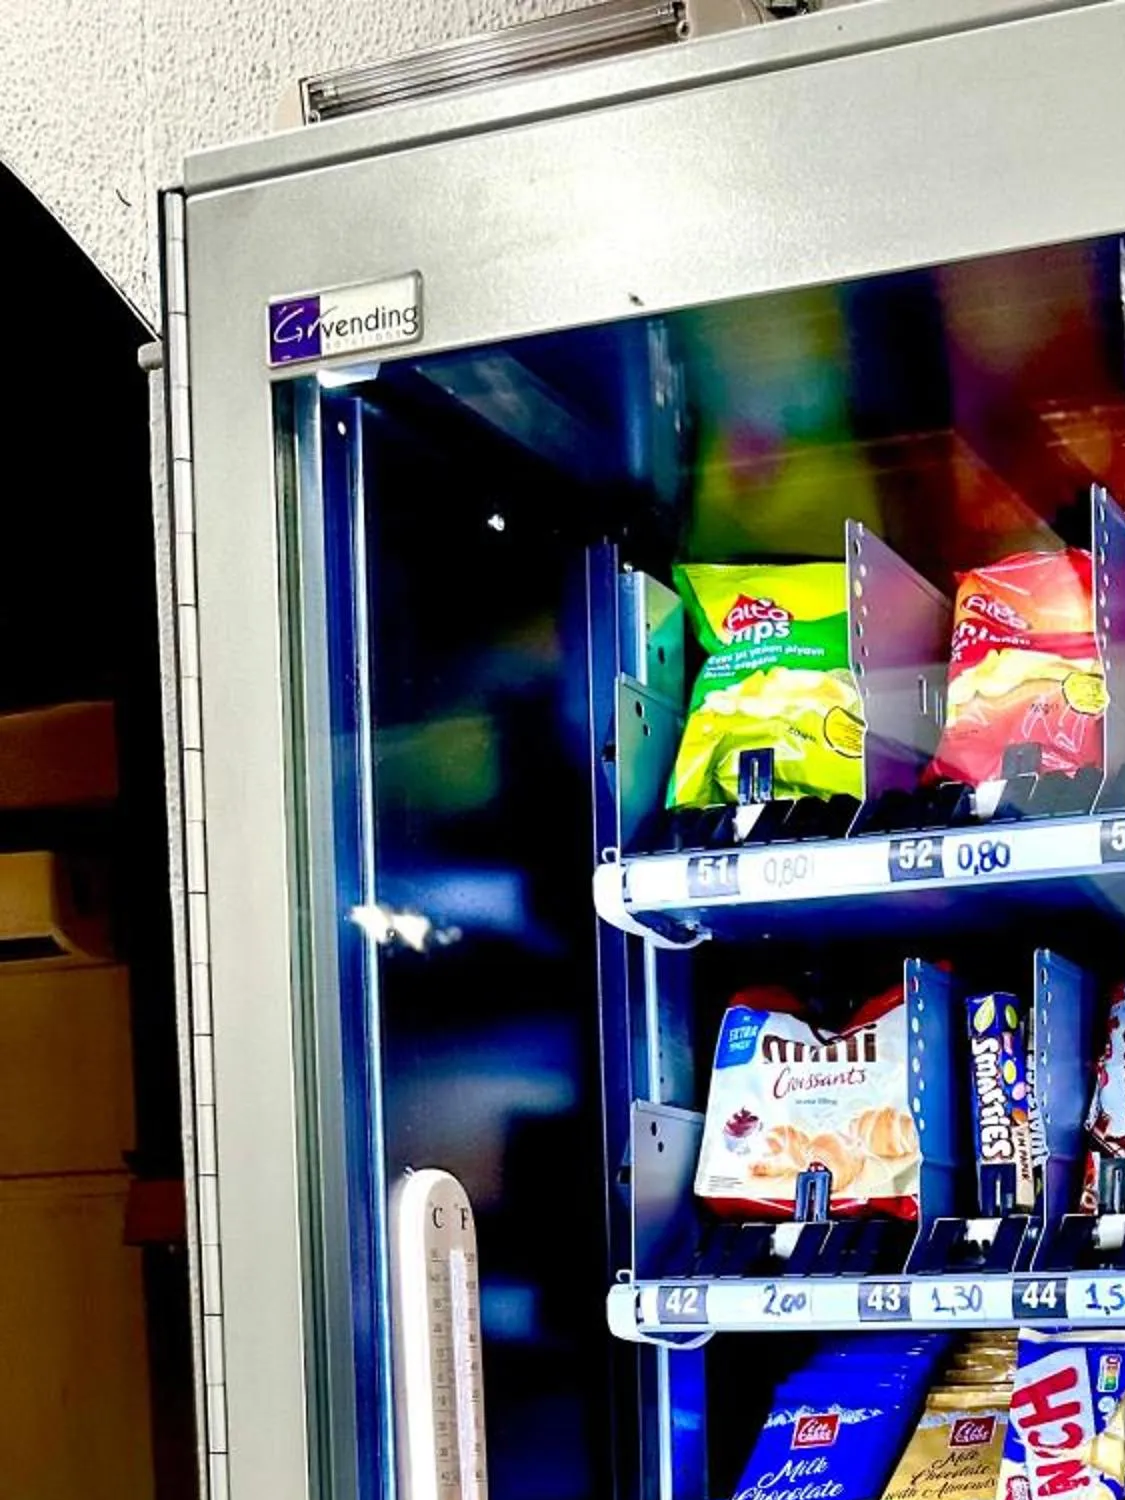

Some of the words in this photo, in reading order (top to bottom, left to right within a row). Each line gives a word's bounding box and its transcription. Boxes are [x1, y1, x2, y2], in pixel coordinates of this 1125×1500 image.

[697, 858, 730, 885] 51
[899, 840, 933, 869] 52
[957, 841, 1011, 876] 0,80
[665, 1288, 698, 1314] 42
[867, 1285, 901, 1311] 43
[1021, 1281, 1057, 1309] 44
[757, 1456, 829, 1489] Milk
